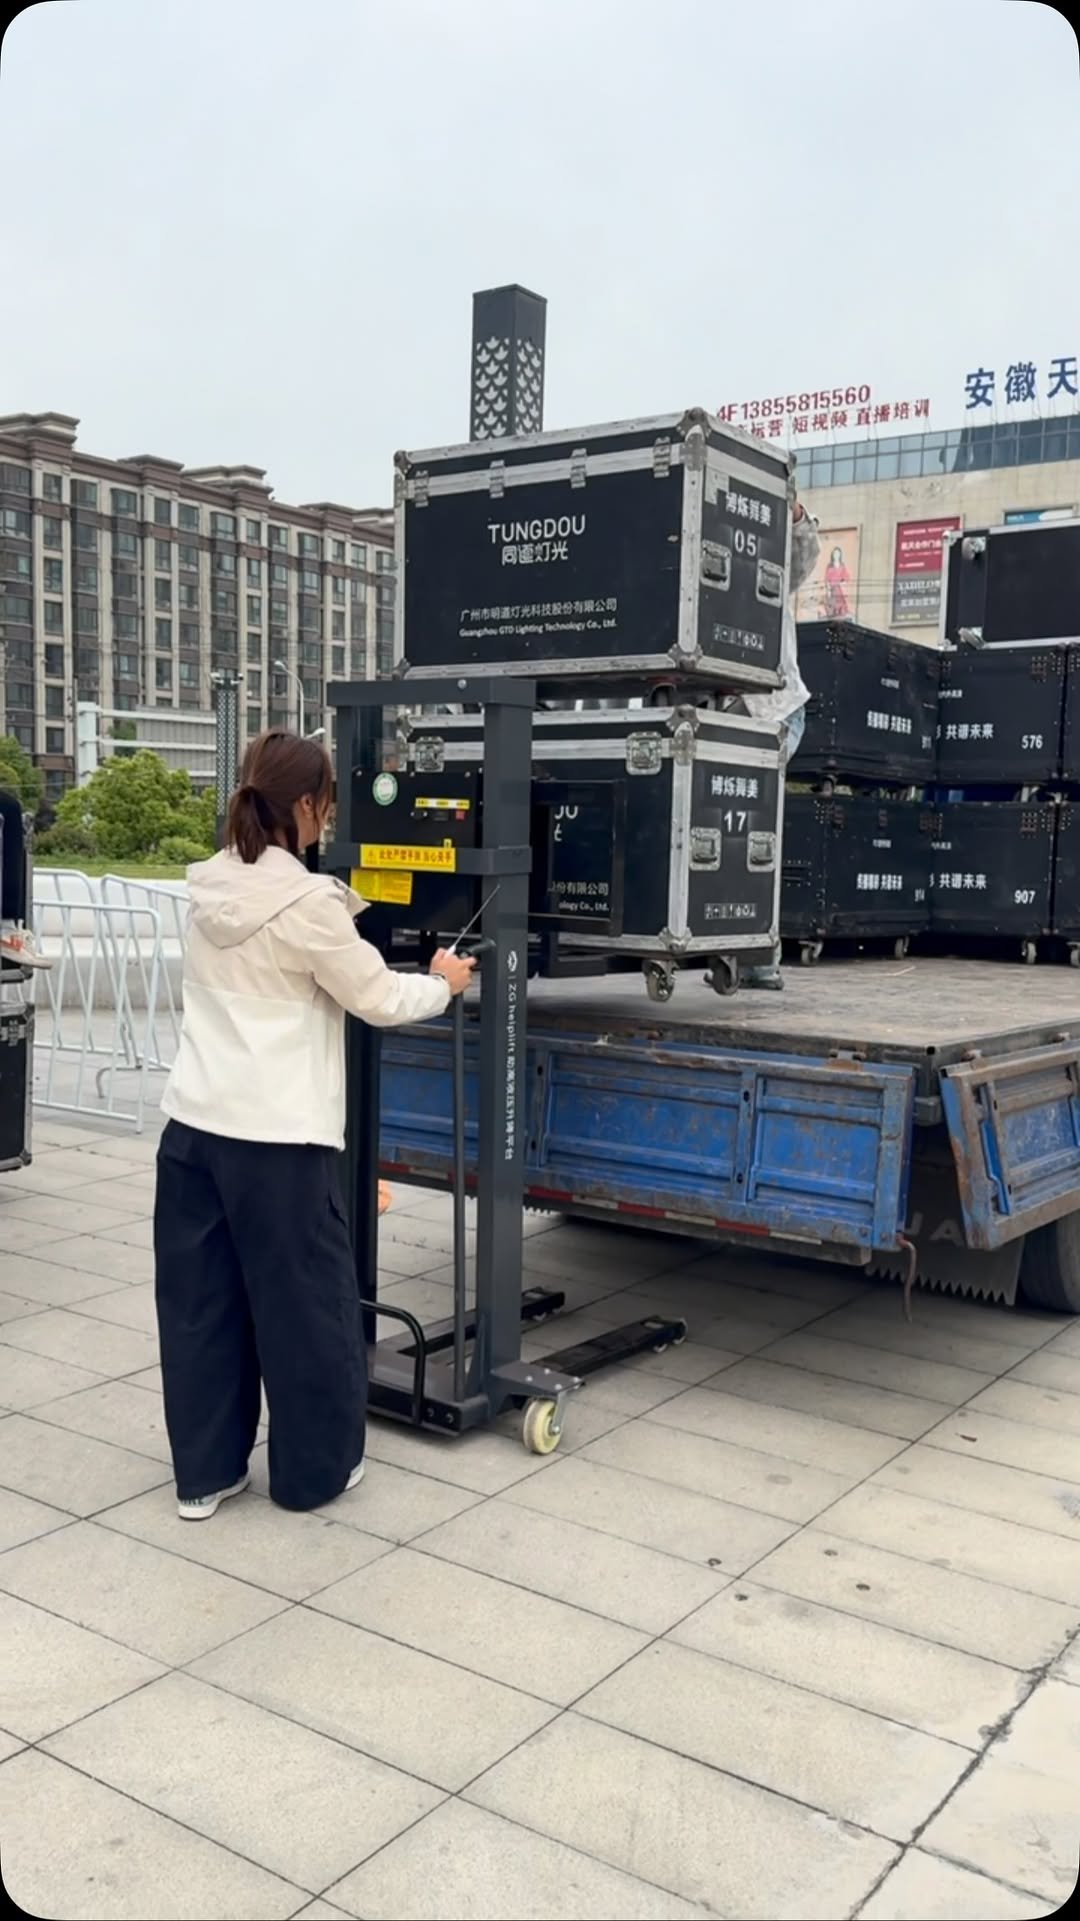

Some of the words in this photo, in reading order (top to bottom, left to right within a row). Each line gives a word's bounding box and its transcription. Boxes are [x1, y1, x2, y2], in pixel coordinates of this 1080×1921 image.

[964, 357, 1078, 410] 安徽天
[791, 409, 848, 434] 短视频
[855, 398, 930, 426] 直播培训
[487, 514, 586, 544] TUNGDOU
[734, 529, 757, 556] 05
[515, 623, 544, 635] Lighting
[545, 620, 586, 631] Technology
[1021, 735, 1044, 750] 576
[724, 810, 747, 833] 17
[1014, 890, 1036, 904] 907
[508, 984, 518, 1002] ZG
